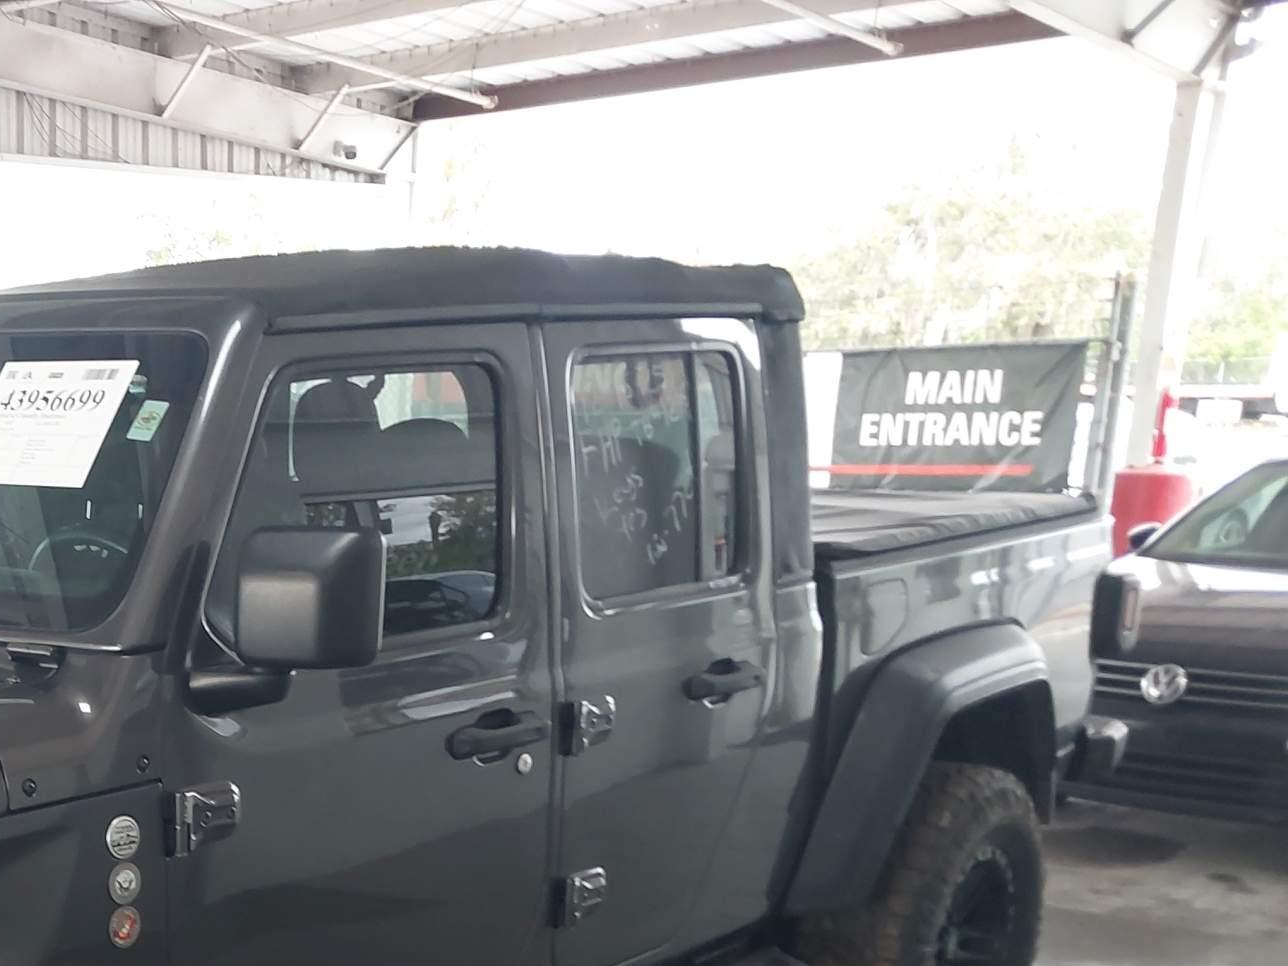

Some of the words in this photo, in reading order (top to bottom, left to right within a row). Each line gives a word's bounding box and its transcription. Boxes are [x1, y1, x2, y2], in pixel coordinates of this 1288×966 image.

[1, 389, 106, 412] 43956699
[905, 369, 1003, 404] MAIN
[859, 411, 1043, 446] ENTRANCE
